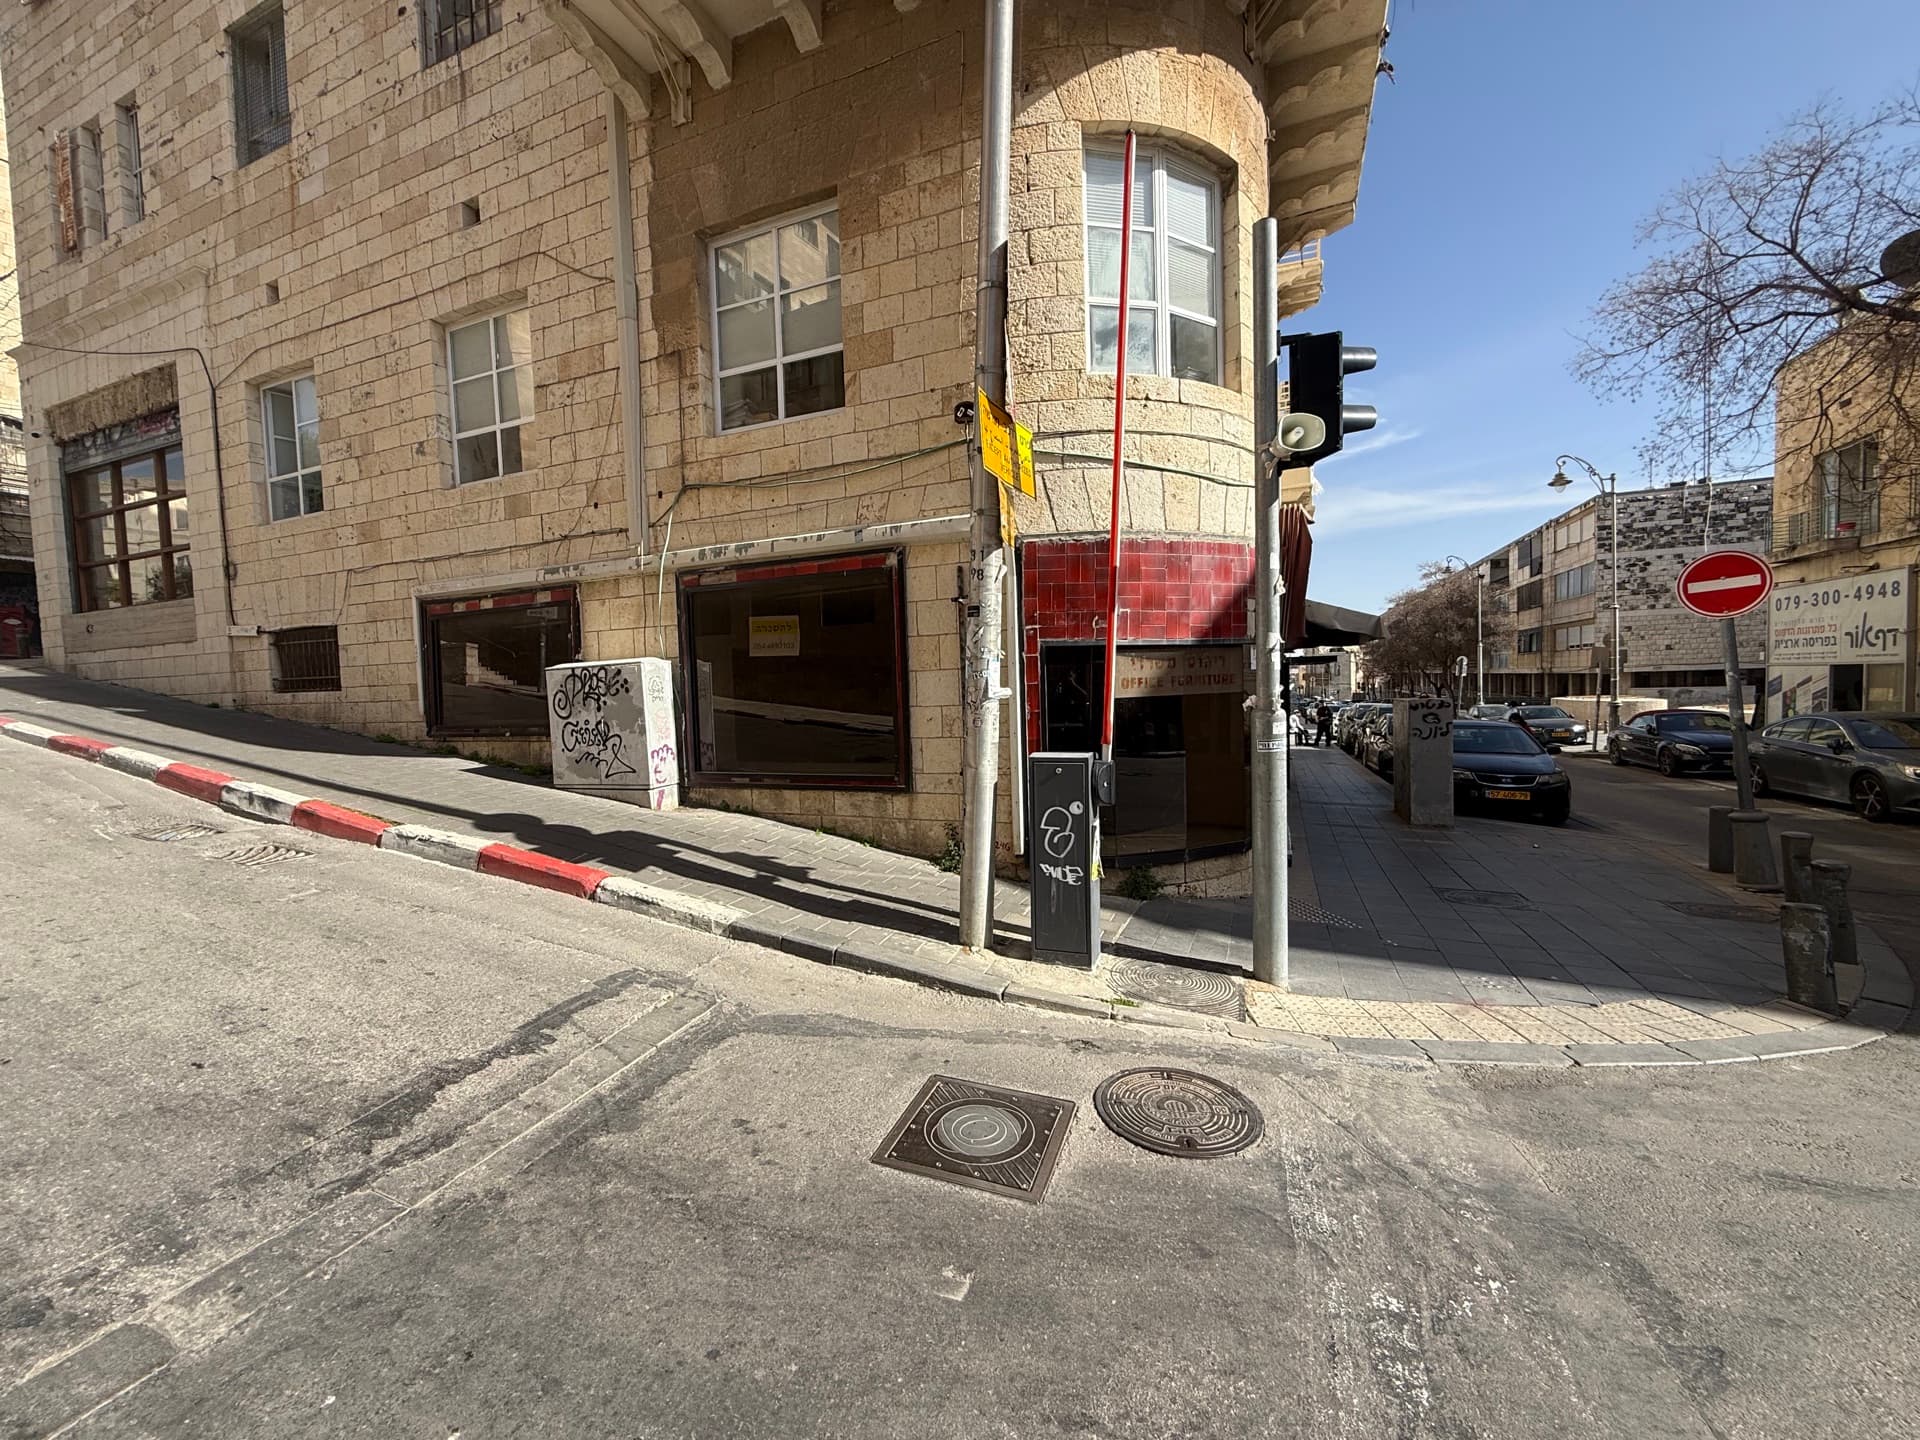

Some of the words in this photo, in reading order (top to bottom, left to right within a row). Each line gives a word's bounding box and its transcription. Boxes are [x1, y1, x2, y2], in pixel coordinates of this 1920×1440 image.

[970, 568, 985, 581] 98
[1775, 580, 1901, 612] 079-300-4948
[1774, 637, 1800, 649] ארצית
[1802, 635, 1838, 648] בפריסה
